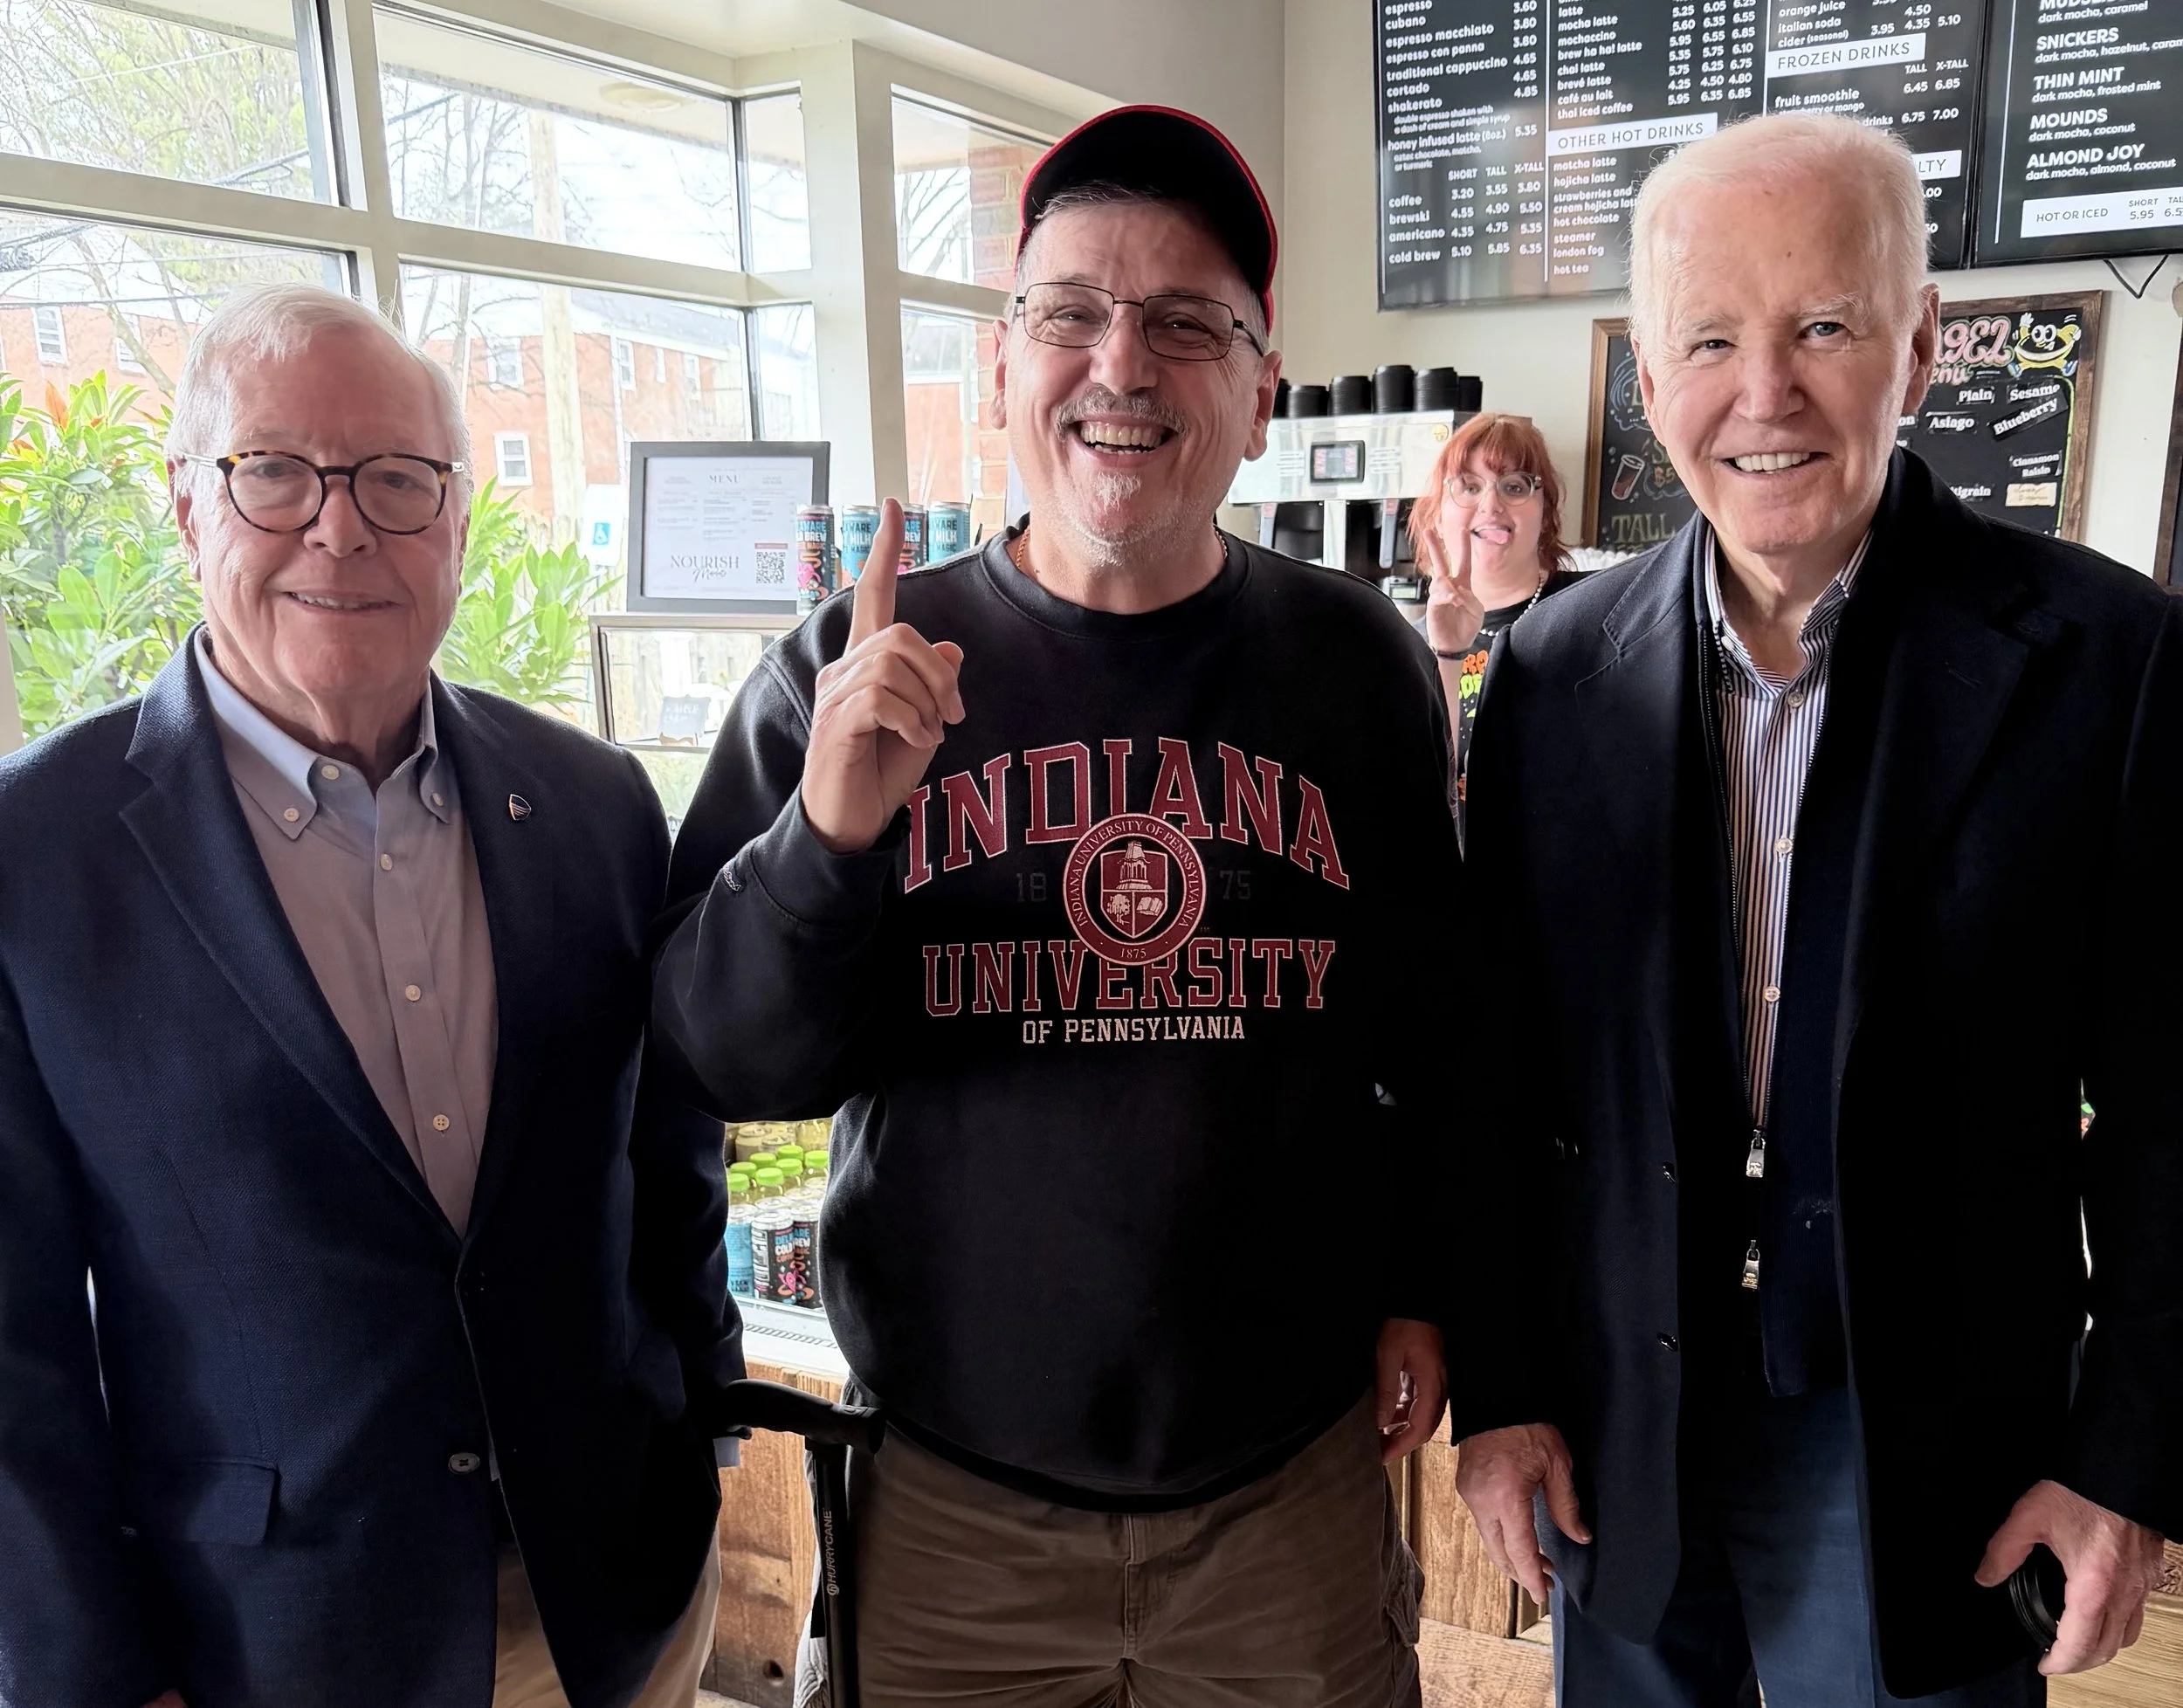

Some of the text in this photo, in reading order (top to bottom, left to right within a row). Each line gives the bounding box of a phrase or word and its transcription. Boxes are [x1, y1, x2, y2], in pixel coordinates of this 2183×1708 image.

[1385, 0, 1432, 16] espresso
[1513, 0, 1537, 13] 3.60
[1559, 7, 1583, 17] latte
[1703, 0, 1726, 13] 6.05
[1779, 1, 1846, 17] orange juice
[1904, 4, 1932, 17] 4.50
[2038, 12, 2062, 23] dark
[2064, 8, 2103, 20] mocha,
[2104, 0, 2148, 14] caramel
[1385, 17, 1426, 30] cubano
[1513, 17, 1537, 31] 3.80
[1558, 16, 1617, 31] mocha latte
[1703, 10, 1755, 28] 6.35 6.55
[1778, 17, 1841, 33] italian soda
[1870, 14, 1961, 36] 3.95 5.10
[1386, 24, 1494, 49] espresso macchiato
[1513, 35, 1537, 48] 3.80
[1558, 31, 1616, 47] mochaccino
[1670, 31, 1725, 47] 5.95 6.55
[1778, 30, 1849, 49] cider (seasonal)
[2036, 27, 2118, 51] SNICKERS
[1386, 42, 1484, 65] espresso con panna
[1558, 42, 1642, 60] brew ha ha! latte
[1703, 42, 1753, 58] 5.75 6.10
[1778, 42, 1911, 70] FROZEN DRINKS
[2035, 43, 2150, 64] dark mocha, hazelnut,
[1513, 52, 1537, 65] 4.65
[1905, 59, 1968, 73] TALL X-TALL
[1387, 57, 1507, 81] traditional cappuccino
[1558, 62, 1605, 75] chai latte
[1669, 58, 1752, 77] 5.75 6.25 6.75
[1513, 70, 1537, 82] 4.65
[1587, 76, 1612, 86] latte
[1668, 72, 1752, 91] 4.25 4.50 4.80
[2034, 66, 2124, 90] THIN MINT
[1387, 82, 1429, 98] cortado
[1935, 78, 1960, 91] 6.85
[2032, 80, 2162, 103] dark mocha, frosted mint
[1558, 93, 1579, 105] café
[1596, 89, 1614, 100] lait
[1668, 87, 1752, 106] 5.95 6.35 6.85
[1774, 88, 1860, 108] fruit smoothie
[1388, 98, 1443, 114] shakerato
[1558, 102, 1633, 119] thai iced coffee
[1835, 101, 1865, 113] mango
[1902, 108, 1959, 124] 6.75 7.00
[2030, 108, 2108, 130] MOUNDS
[1558, 122, 1704, 148] OTHER HOT DRINKS
[2029, 122, 2136, 142] dark mocha, coconut
[1388, 132, 1481, 150] honey infused latte
[1553, 157, 1617, 171] matcha latte
[2027, 143, 2145, 169] ALMOND JOY
[1449, 162, 1544, 180] SHORT TALL X-TALL
[2026, 158, 2176, 182] dark mocha, almond, coconut
[1554, 173, 1616, 188] hojicha latte
[1389, 195, 1422, 208] coffee
[1554, 185, 1632, 203] strawberries and
[1553, 203, 1582, 214] cream
[2129, 198, 2159, 207] SHORT
[1389, 210, 1430, 224] brewski
[1553, 214, 1619, 227] hot chocolate
[2036, 208, 2108, 222] HOT OR ICED
[2130, 210, 2154, 220] 5.95
[1389, 229, 1445, 243] americano
[1554, 232, 1596, 244] steamer
[1389, 250, 1441, 264] cold brew
[1553, 245, 1604, 258] london fog
[1553, 265, 1570, 274] hot
[1930, 367, 1966, 385] enu
[1959, 384, 2061, 403] Plain Sesame
[1930, 417, 1974, 431] Asiago
[1994, 398, 2057, 435] Blueberry
[2013, 454, 2059, 466] Cinnamon
[709, 475, 740, 485] MENU
[1951, 486, 1991, 499] tigrain
[671, 555, 739, 569] NOURISH
[905, 737, 1350, 895] INDIANA
[1076, 821, 1200, 927] UNIVERSITY OF PENNSYLVANIA
[1070, 868, 1088, 927] INDIANA
[1121, 948, 1146, 959] 1875
[922, 937, 1336, 1016] UNIVERSITY
[1023, 1016, 1245, 1044] OF PENNSYLVANIA
[823, 1510, 837, 1583] HURRYCANE
